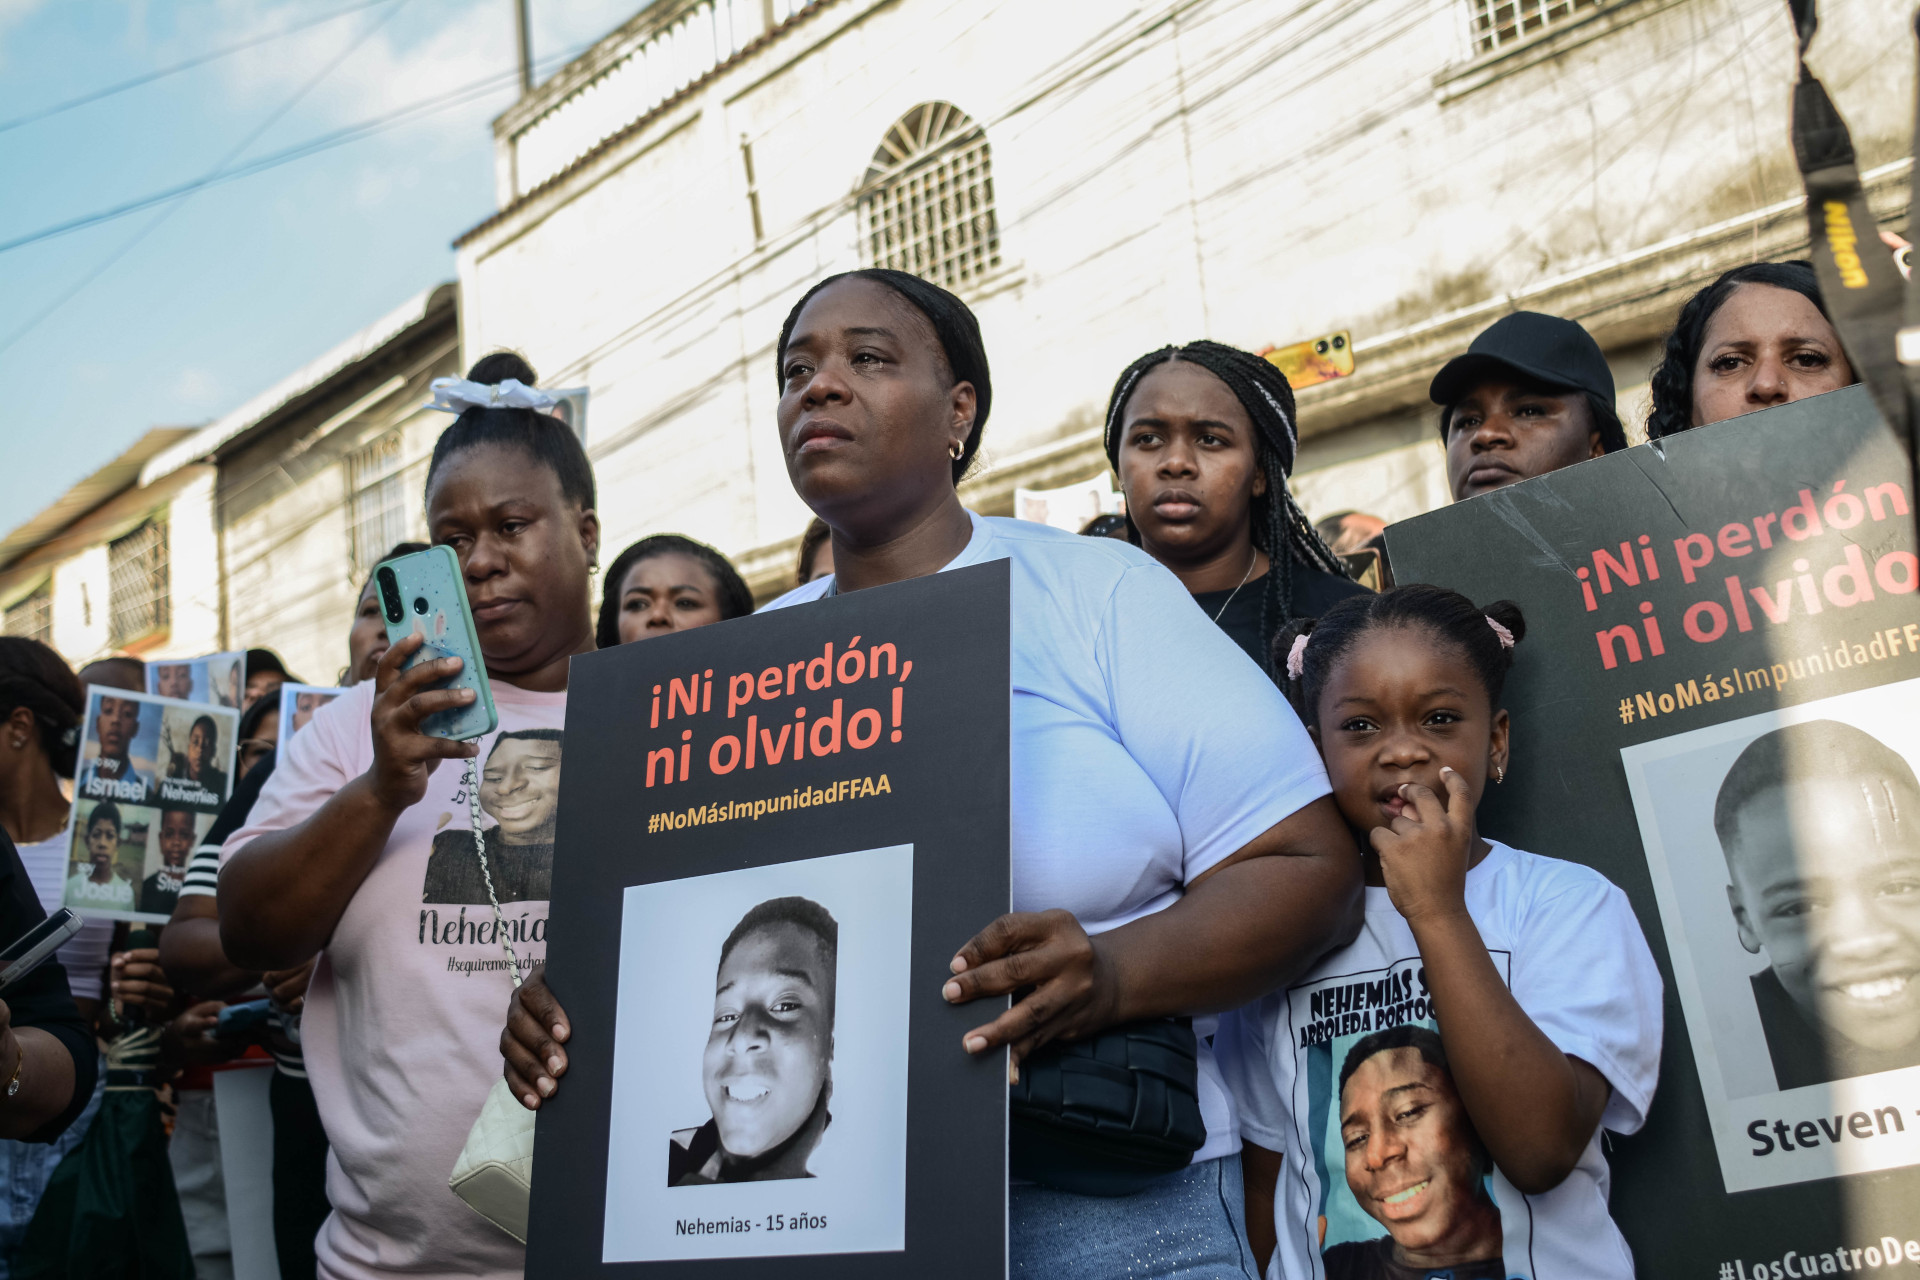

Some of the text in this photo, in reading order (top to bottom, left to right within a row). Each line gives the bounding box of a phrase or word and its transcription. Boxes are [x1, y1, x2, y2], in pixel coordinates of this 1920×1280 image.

[1577, 534, 1660, 612] ¡Ni
[1595, 544, 1919, 671] ni olvido
[650, 635, 913, 729] ¡Ni perdón,
[645, 686, 903, 788] ni olvido!
[86, 769, 148, 800] Ismael
[647, 773, 891, 834] #NoMásImpunidadFFAA
[1310, 967, 1412, 1021] NEHEMÍAS
[1300, 1010, 1372, 1049] ARBOLEDA
[1747, 1105, 1905, 1157] Steven
[675, 1217, 751, 1236] Nehemias
[766, 1214, 785, 1231] 15
[789, 1212, 827, 1230] años
